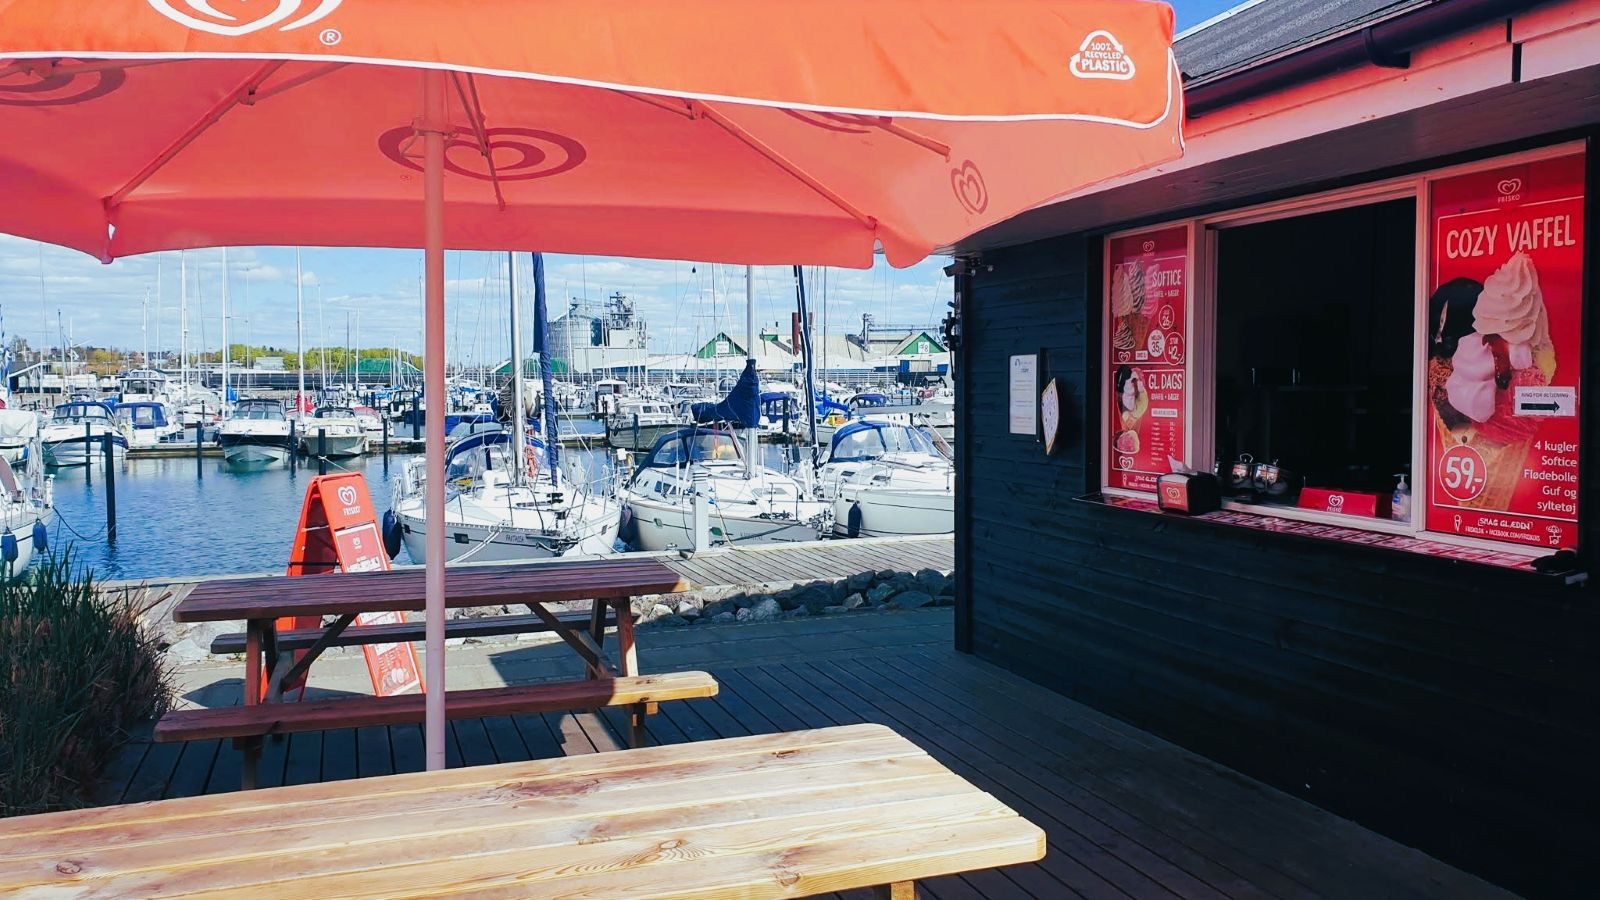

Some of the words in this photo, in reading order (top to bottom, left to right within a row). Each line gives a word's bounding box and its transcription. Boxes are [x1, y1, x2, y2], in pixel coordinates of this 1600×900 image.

[1090, 42, 1112, 51] 100%
[1085, 51, 1121, 59] RECYCLED
[1081, 58, 1127, 72] PLASTIC
[1497, 194, 1521, 203] FRISKO
[1446, 224, 1498, 259] COZY
[1506, 214, 1576, 252] VAFFEL
[1152, 268, 1182, 288] SOFTICE
[1148, 373, 1160, 390] GL.
[1161, 373, 1183, 390] DAGS
[1534, 440, 1541, 449] 4
[1544, 440, 1578, 453] kugler
[1541, 456, 1578, 467] Softice
[1444, 456, 1483, 494] 59,-
[1524, 469, 1577, 483] Flødebolle
[1543, 485, 1561, 496] Guf
[1564, 489, 1577, 499] og
[1537, 500, 1577, 515] syltetøj
[1479, 517, 1499, 527] SMAG
